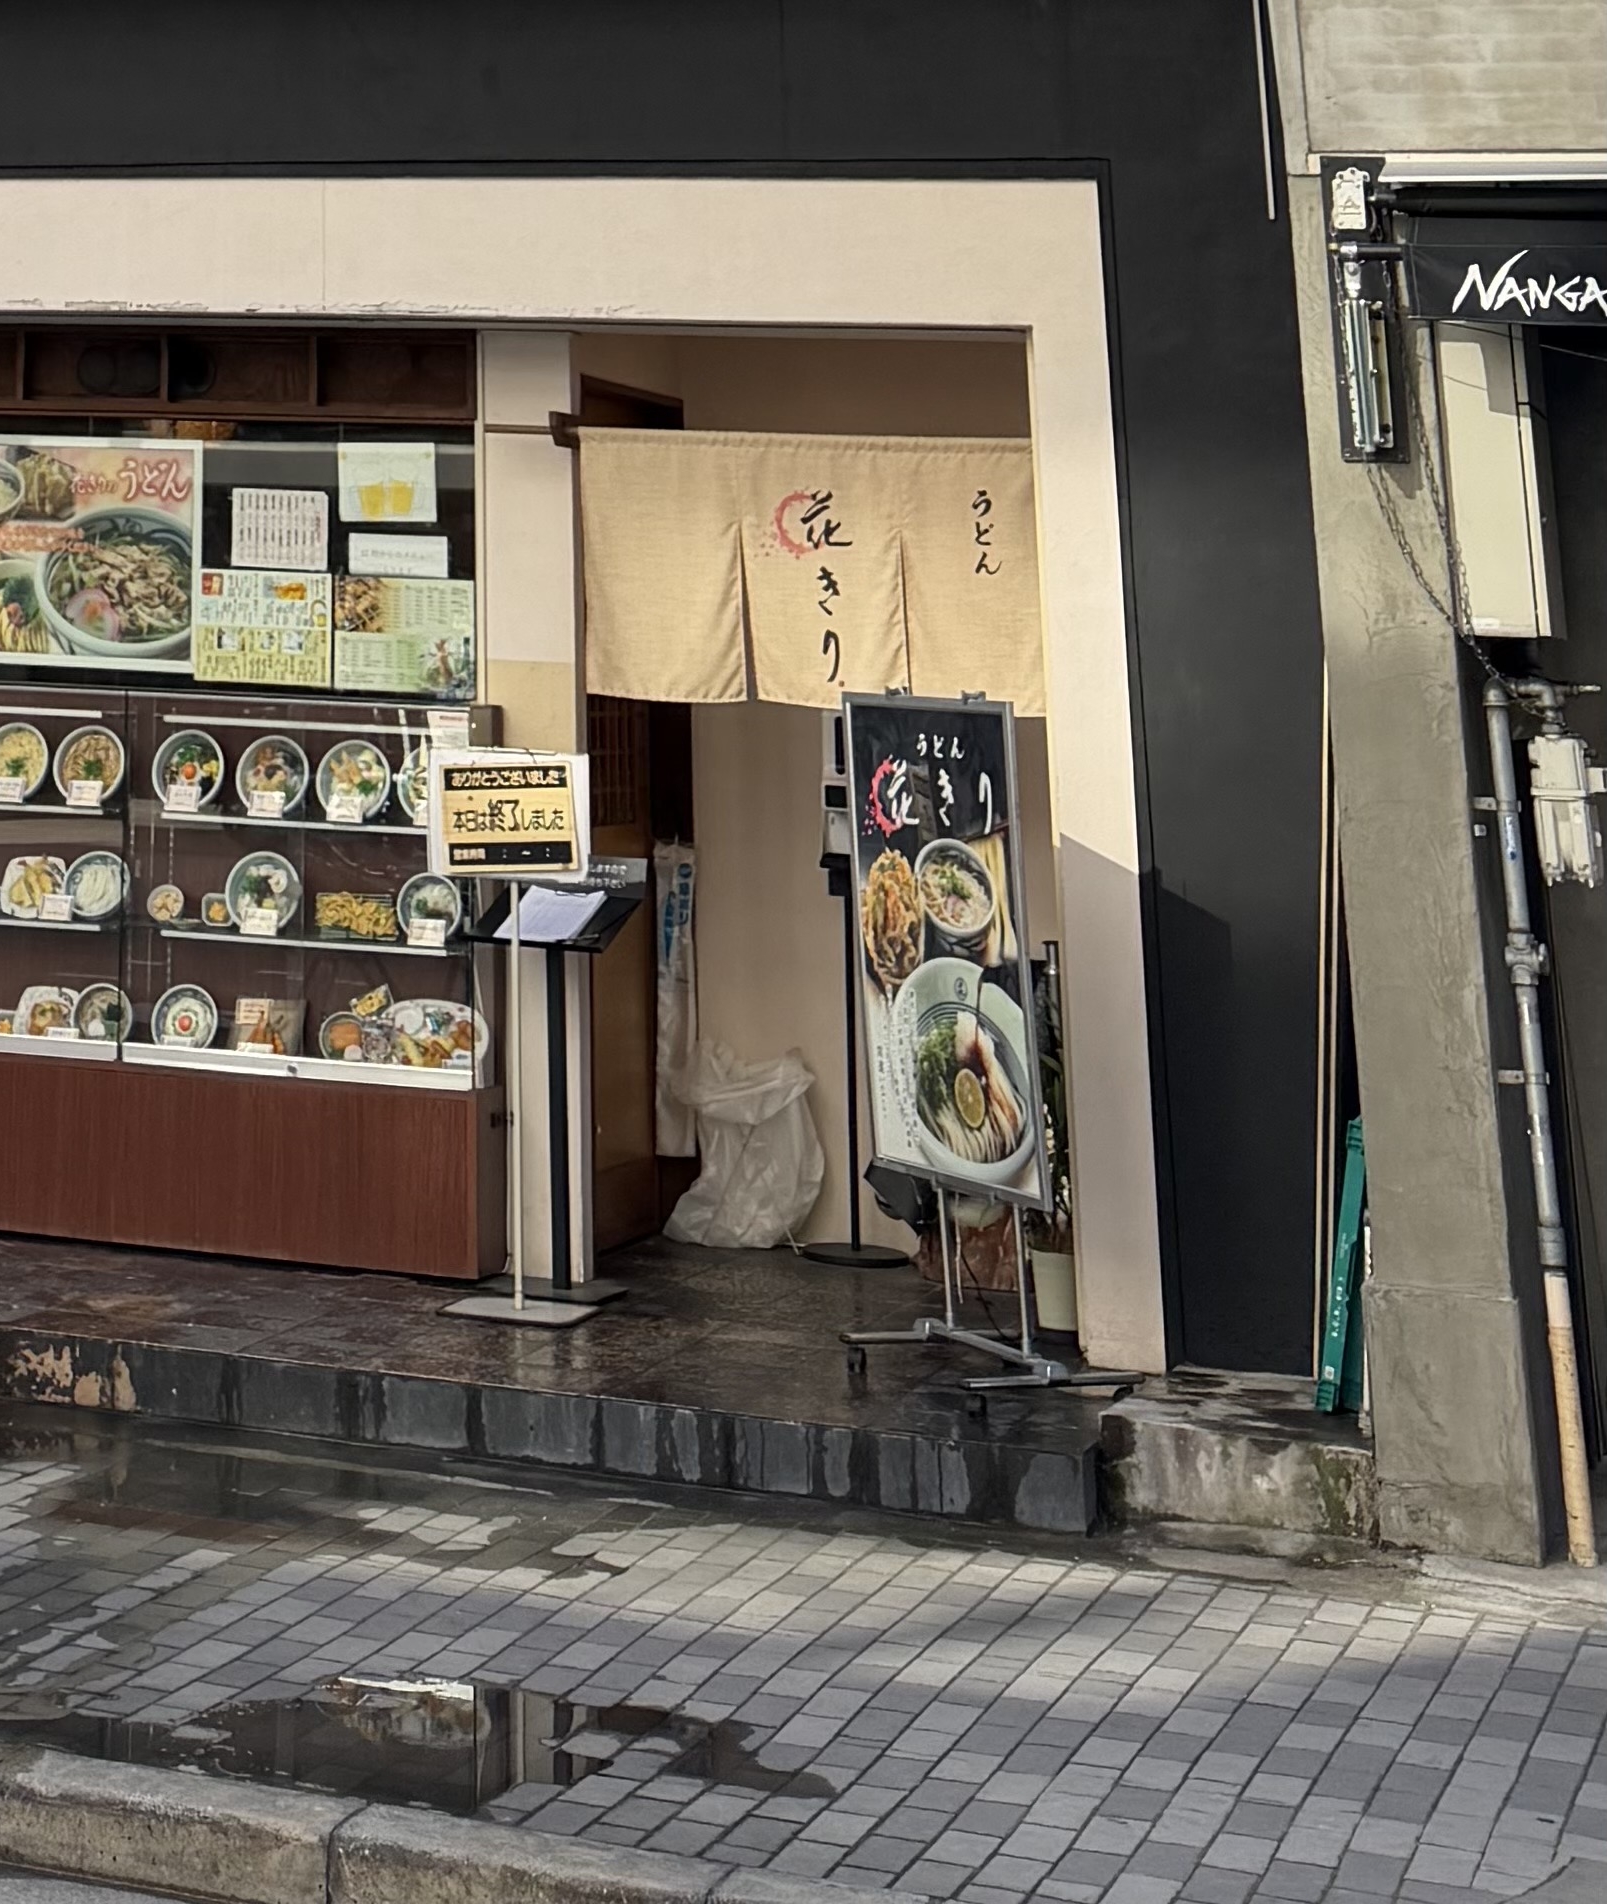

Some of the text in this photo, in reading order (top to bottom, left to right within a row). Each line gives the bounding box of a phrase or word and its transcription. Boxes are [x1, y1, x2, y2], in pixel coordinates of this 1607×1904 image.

[1452, 249, 1607, 317] NANGA
[119, 458, 190, 501] うどん
[972, 490, 1002, 576] うどん
[800, 490, 853, 683] 花きり
[916, 733, 965, 759] うどん
[451, 769, 560, 787] ありがとうございました
[887, 759, 993, 835] 花きり
[452, 798, 564, 833] 本日は終了しました
